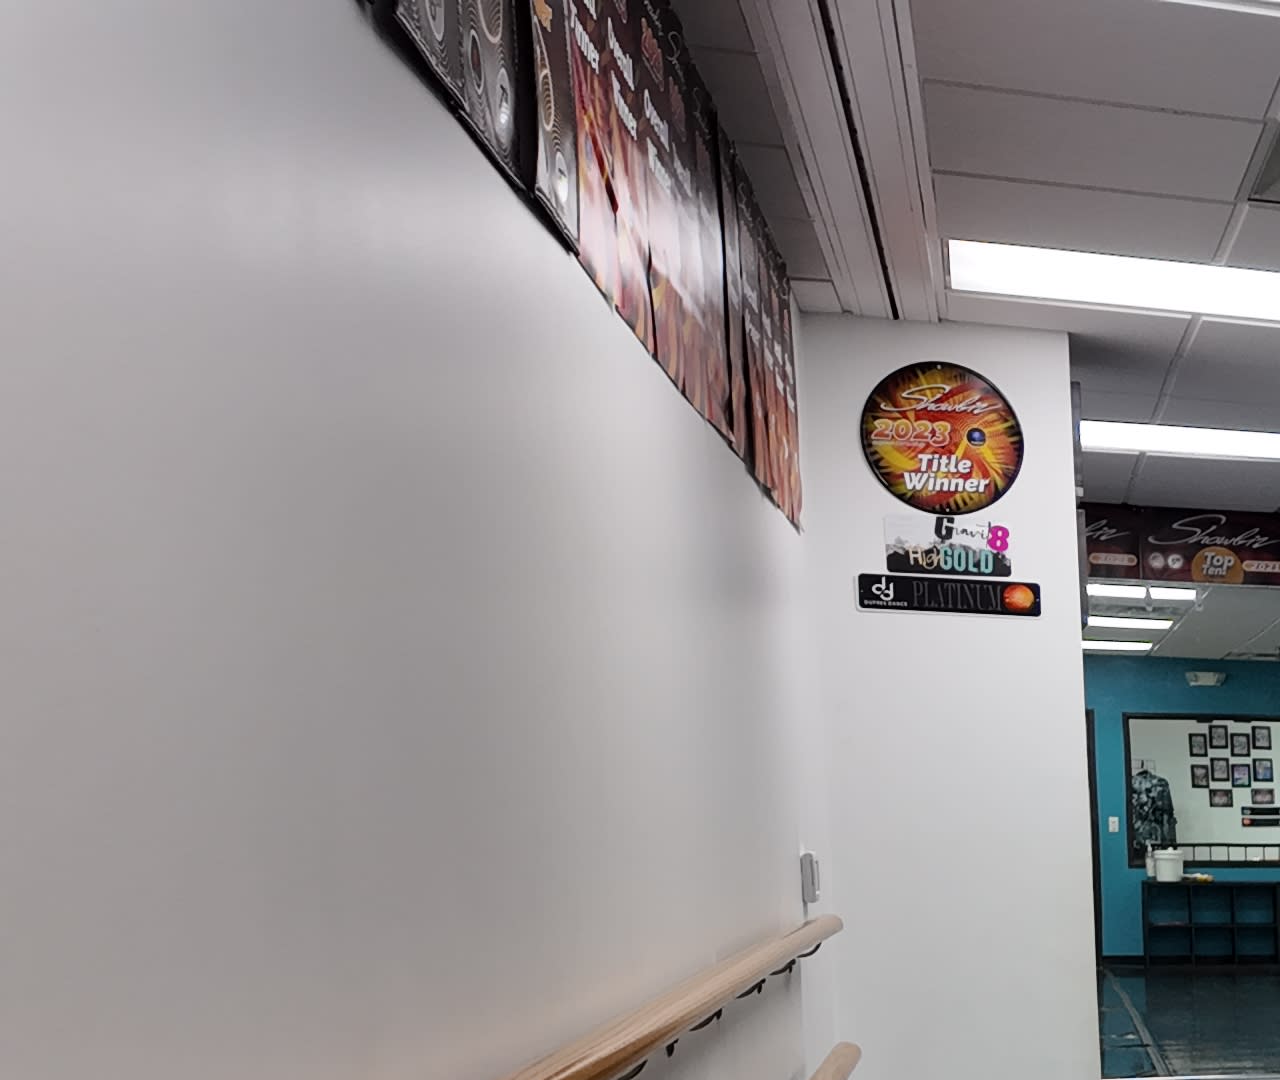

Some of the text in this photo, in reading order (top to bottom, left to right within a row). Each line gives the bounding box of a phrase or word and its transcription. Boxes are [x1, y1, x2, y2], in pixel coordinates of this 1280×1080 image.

[880, 384, 1002, 414] Showbiz
[871, 418, 951, 447] 2023
[917, 453, 973, 474] Title
[903, 472, 990, 493] Winner
[1148, 514, 1280, 549] Showbiz
[940, 546, 994, 574] GOLD
[1203, 551, 1235, 568] Top
